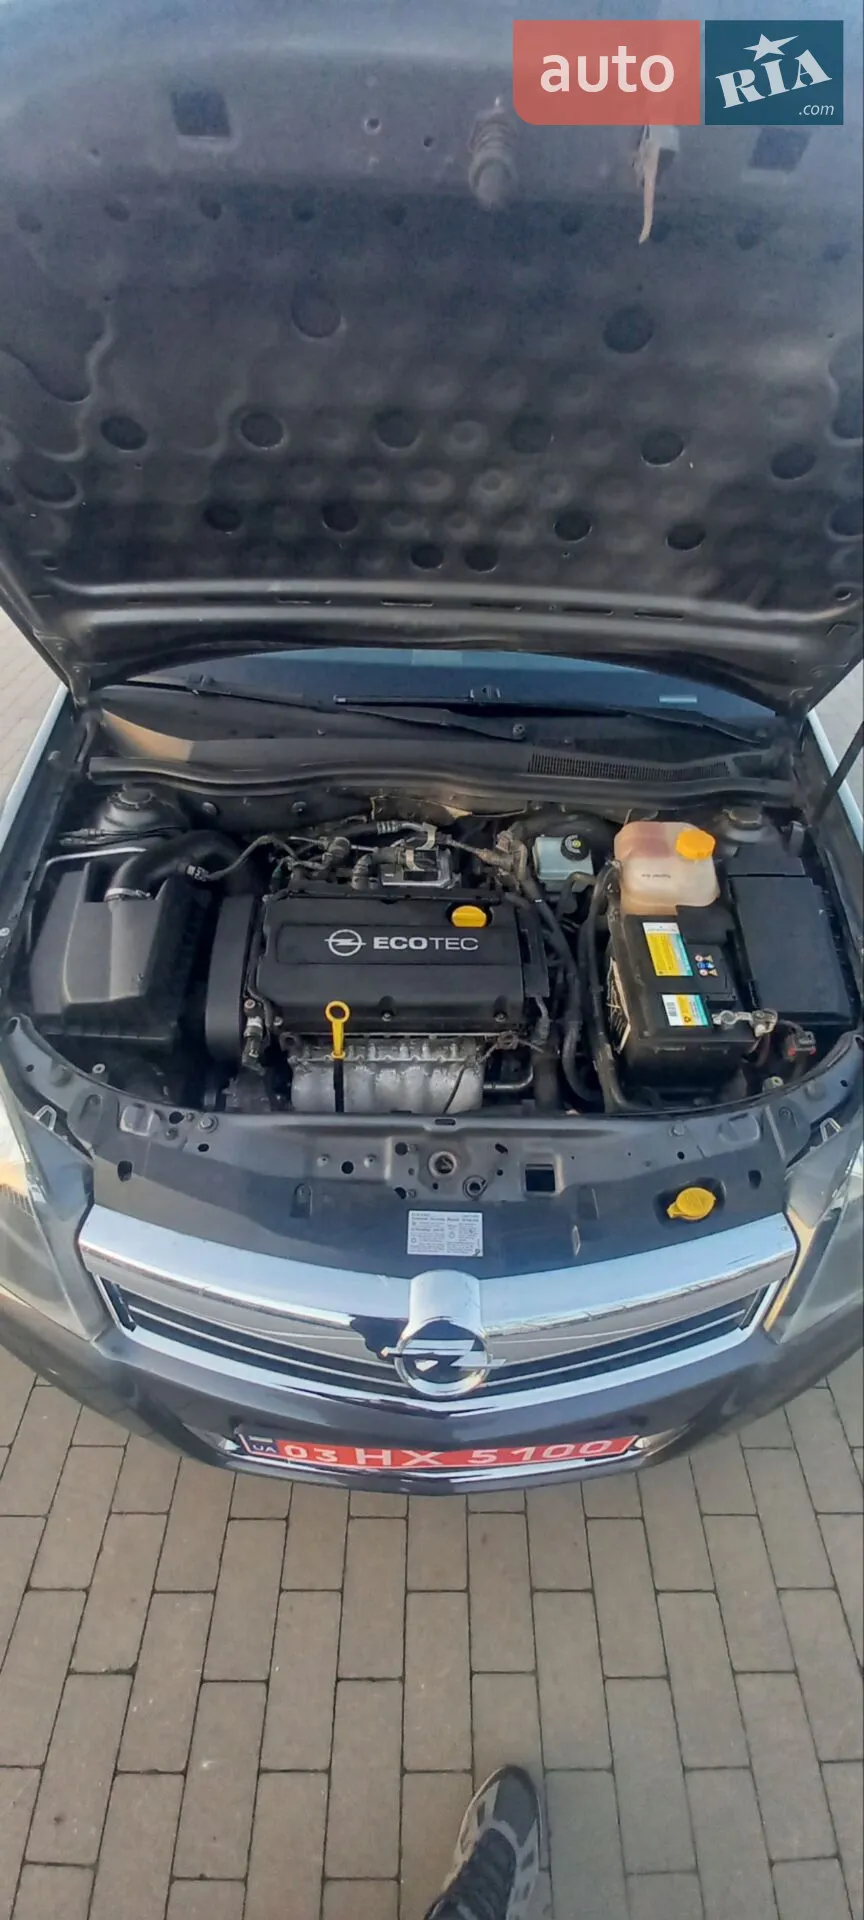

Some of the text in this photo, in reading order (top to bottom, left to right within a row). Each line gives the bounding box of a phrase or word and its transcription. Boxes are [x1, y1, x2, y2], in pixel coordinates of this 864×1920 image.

[373, 936, 479, 951] ECOTEC
[252, 1440, 613, 1466] UA 03 HX 5100
